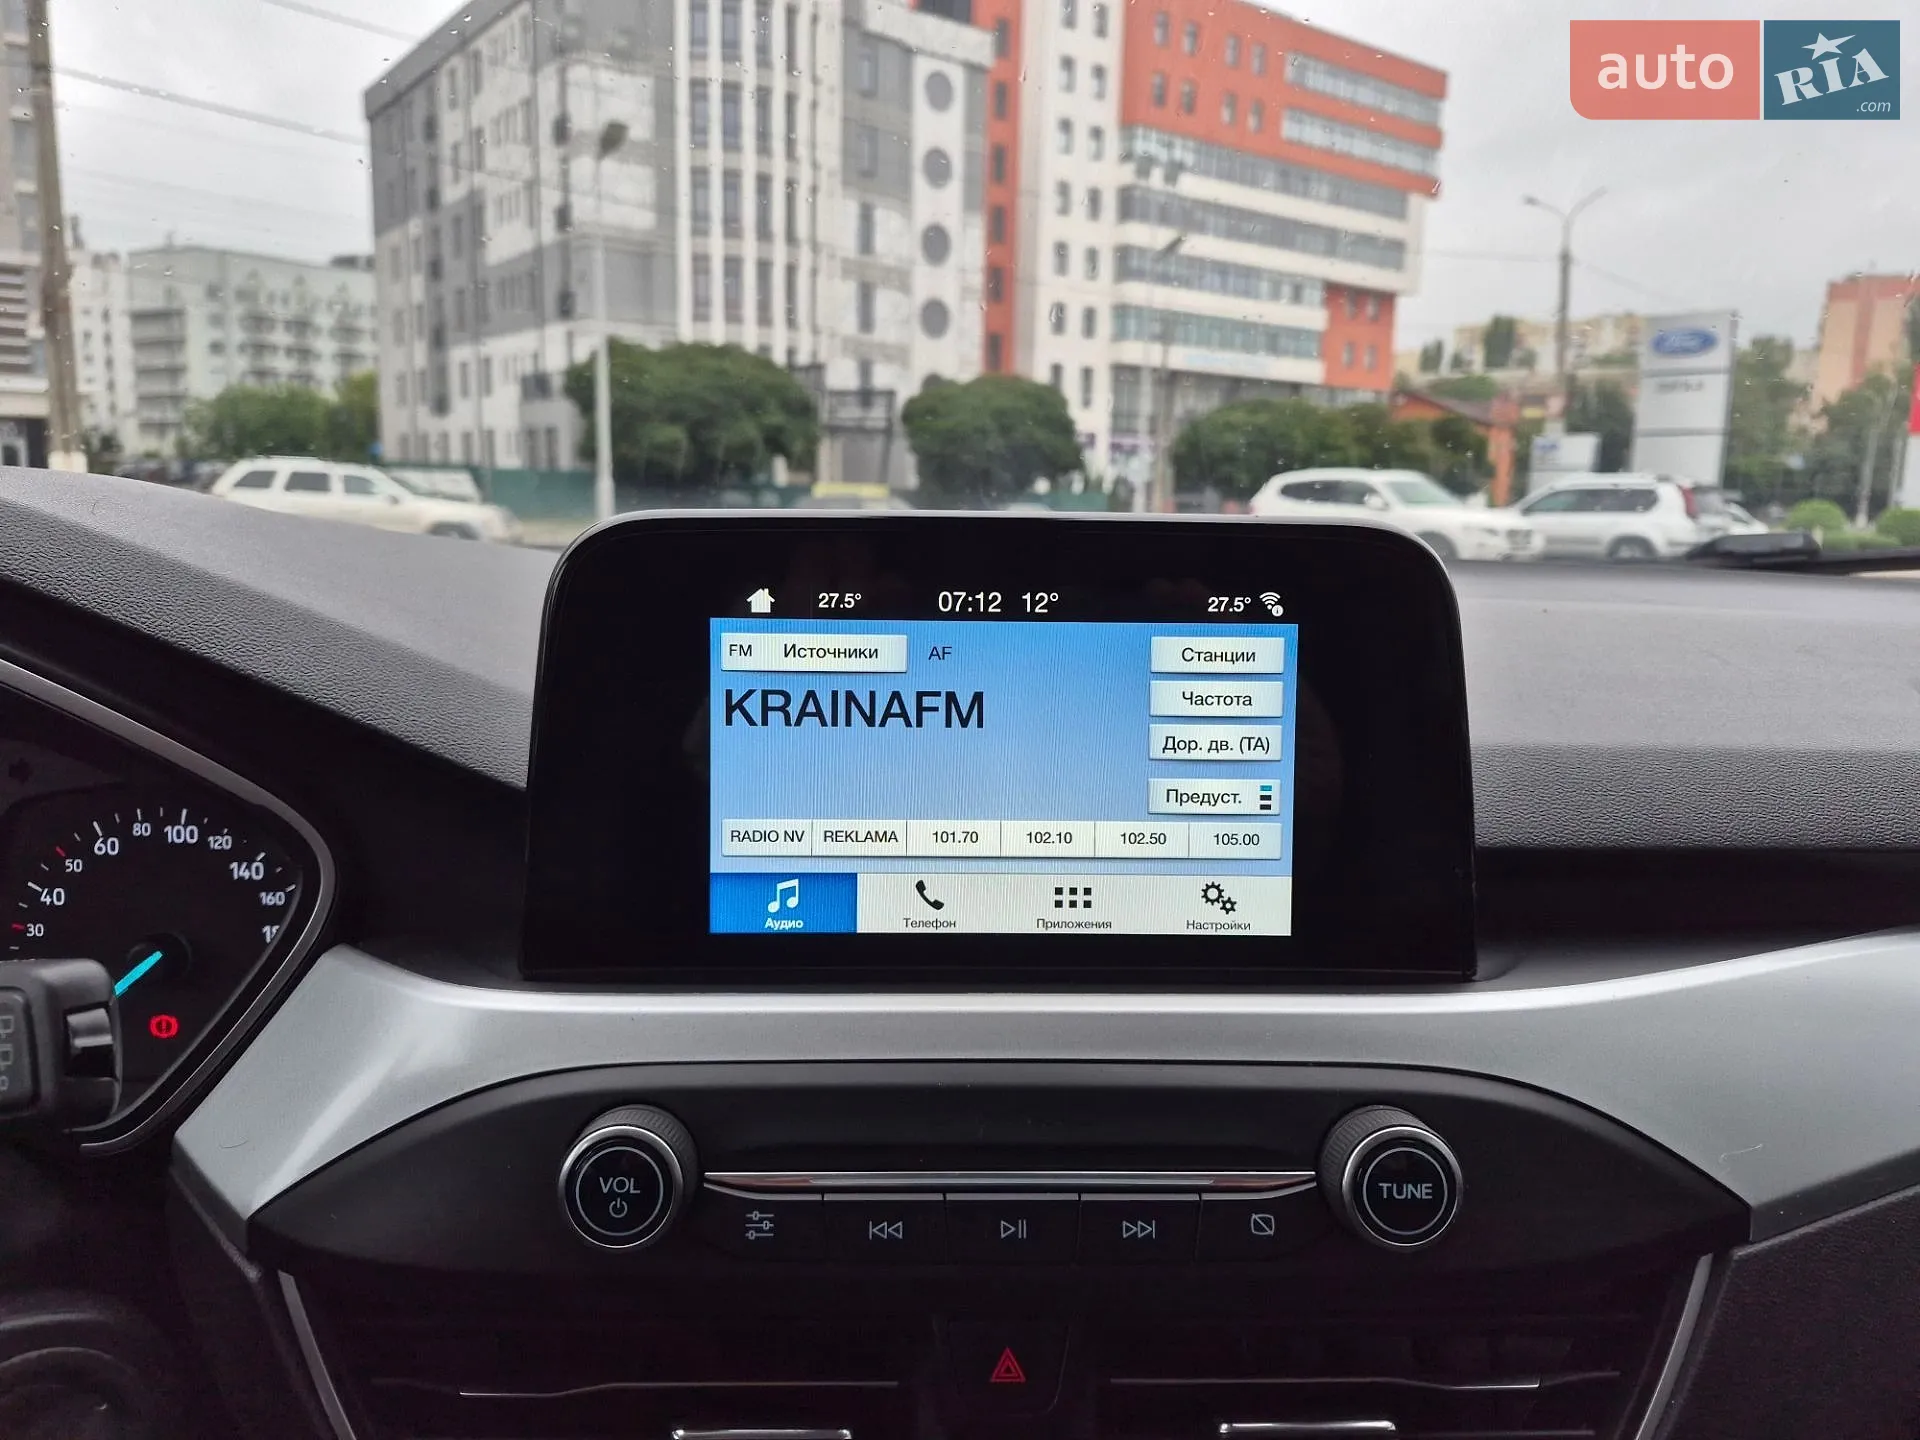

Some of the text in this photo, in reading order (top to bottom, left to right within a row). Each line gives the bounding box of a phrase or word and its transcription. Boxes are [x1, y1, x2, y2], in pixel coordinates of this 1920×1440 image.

[818, 592, 862, 609] 27.5°
[938, 591, 1059, 613] 07:12 12°
[1207, 596, 1252, 612] 27.5°
[728, 644, 753, 657] FM
[783, 643, 879, 659] Источники
[928, 646, 953, 661] AF
[1181, 647, 1256, 664] Станции
[1181, 691, 1253, 706] Частота
[725, 688, 984, 729] KRAINAFM
[1162, 736, 1203, 754] Дор.
[1207, 737, 1234, 753] дв.
[1165, 788, 1242, 806] Предуст.
[132, 822, 151, 837] 80
[163, 825, 199, 844] 100
[730, 830, 805, 843] RADIO NV
[823, 830, 899, 843] REKLAMA
[207, 835, 233, 850] 120
[932, 831, 979, 844] 101.70
[1026, 831, 1073, 845] 102.10
[1120, 832, 1167, 845] 102.50
[1213, 833, 1260, 846] 105.00
[93, 837, 120, 856] 60
[64, 858, 83, 873] 50
[229, 861, 265, 880] 140
[40, 887, 66, 906] 40
[259, 891, 286, 906] 160
[26, 923, 44, 937] 30
[764, 917, 804, 930] Аудио
[903, 917, 957, 931] Телефон
[1036, 918, 1112, 931] Приложения
[1186, 919, 1251, 932] Настройки
[599, 1177, 641, 1194] VOL
[1378, 1183, 1433, 1199] TUNE
